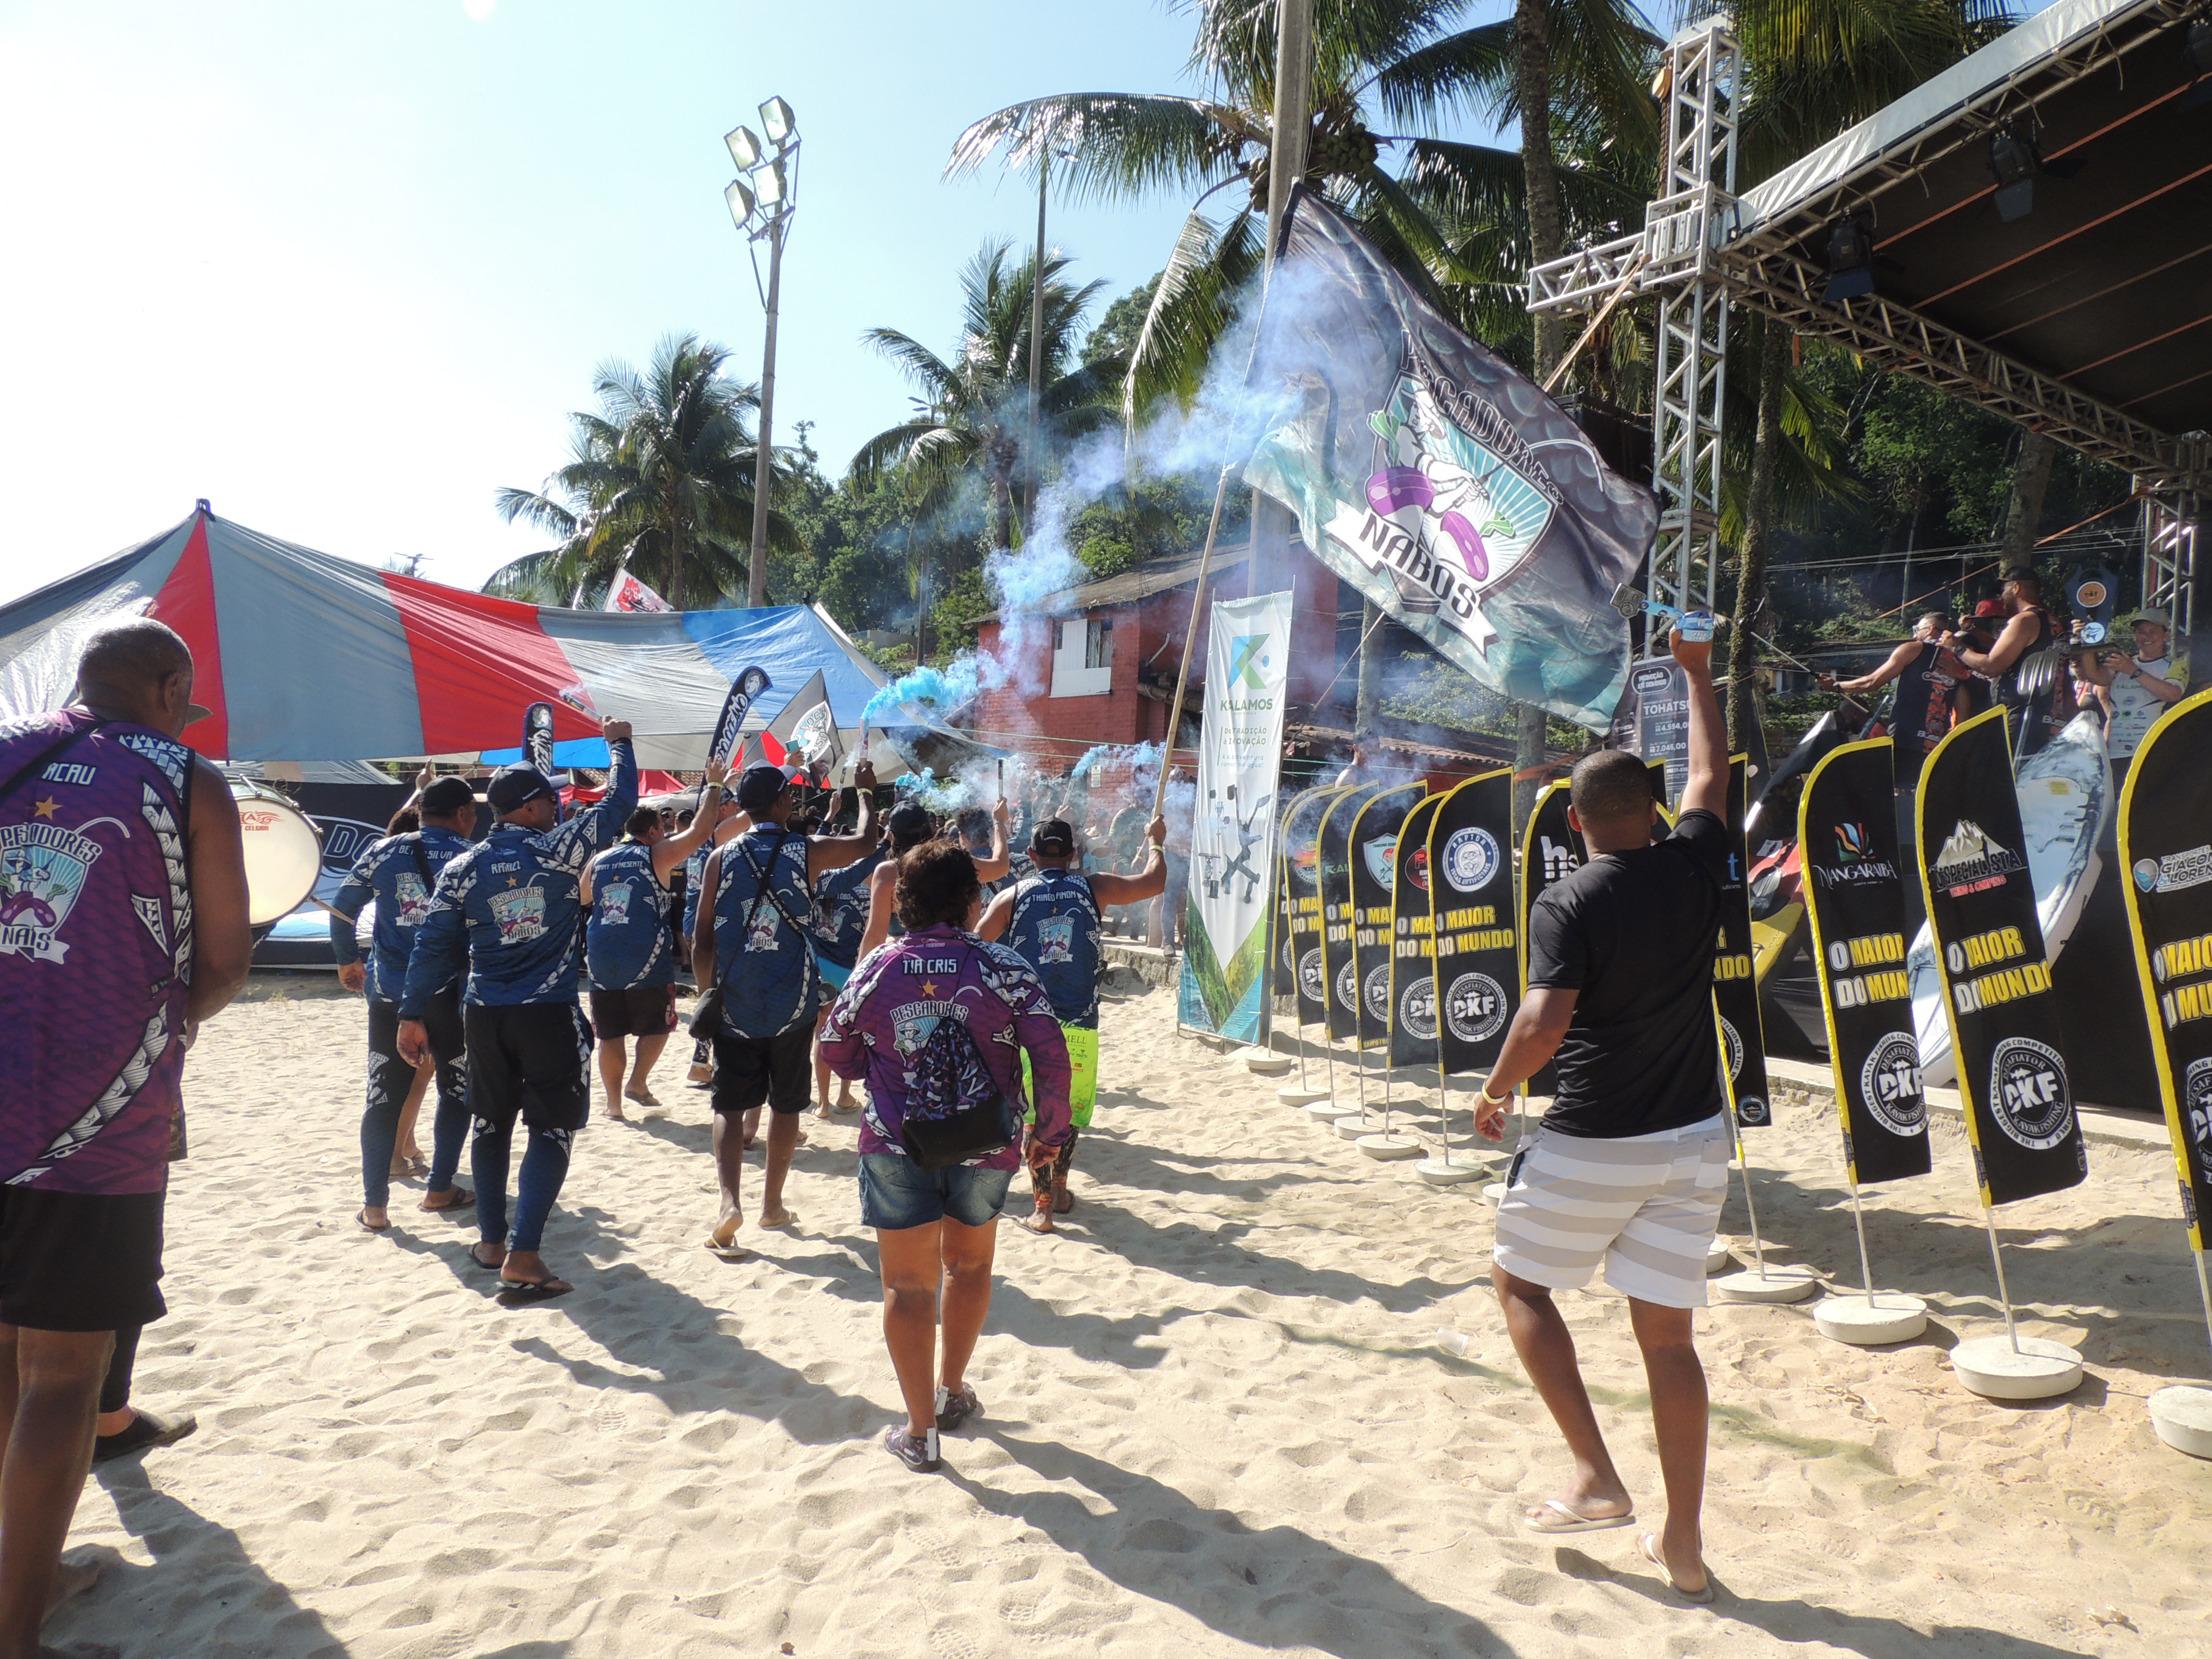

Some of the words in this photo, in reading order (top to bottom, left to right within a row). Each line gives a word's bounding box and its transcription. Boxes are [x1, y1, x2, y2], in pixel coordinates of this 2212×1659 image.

[1401, 329, 1564, 505] PCADORES
[1358, 512, 1478, 619] NABOS
[1220, 698, 1273, 711] KALAMOS
[1232, 726, 1267, 736] TRADIÇÃO
[0, 824, 102, 864] PESDORES
[1452, 833, 1487, 849] RAPTOR
[427, 850, 454, 860] SILVA
[396, 872, 425, 884] PESCA
[1450, 867, 1462, 884] ISCAS
[1462, 862, 1491, 885] ARTIFICIAIS
[1937, 848, 2022, 888] SPECIALISTA
[1396, 916, 1408, 935] O
[1435, 912, 1445, 933] O
[1445, 905, 1496, 931] MAIOR
[2, 927, 51, 951] NAS
[508, 926, 541, 941] NABOS
[1327, 923, 1347, 943] DO
[1357, 928, 1376, 948] DO
[1437, 936, 1455, 958] DO
[1456, 928, 1515, 955] MUNDO
[1395, 938, 1418, 959] DO
[1828, 940, 1850, 972] O
[1848, 932, 1905, 968] MAIOR
[1947, 941, 1964, 974] O
[1960, 925, 2027, 971] MAIOR
[902, 959, 923, 974] TIA
[926, 959, 957, 974] CRIS
[1455, 982, 1491, 1000] DESAFIATOR
[1472, 974, 1505, 1000] COMPETITION
[1834, 975, 1868, 1010] DO
[1976, 958, 2053, 1009] MUNDO
[890, 1001, 969, 1023] PESCADORES
[1454, 995, 1495, 1020] DKF
[1456, 1019, 1474, 1033] KAYAK
[1473, 1014, 1496, 1033] FISHING
[1863, 1056, 1876, 1087] KAYAK
[1875, 1034, 1896, 1056] FISHING
[2004, 1070, 2059, 1114] DKF
[1864, 1089, 1889, 1127] BIGGEST
[1885, 1103, 1908, 1122] KAYAK
[2040, 1100, 2065, 1132] FISHING
[1888, 1122, 1902, 1134] THE
[1994, 1102, 2020, 1141] BIGGEST
[2020, 1135, 2036, 1148] THE
